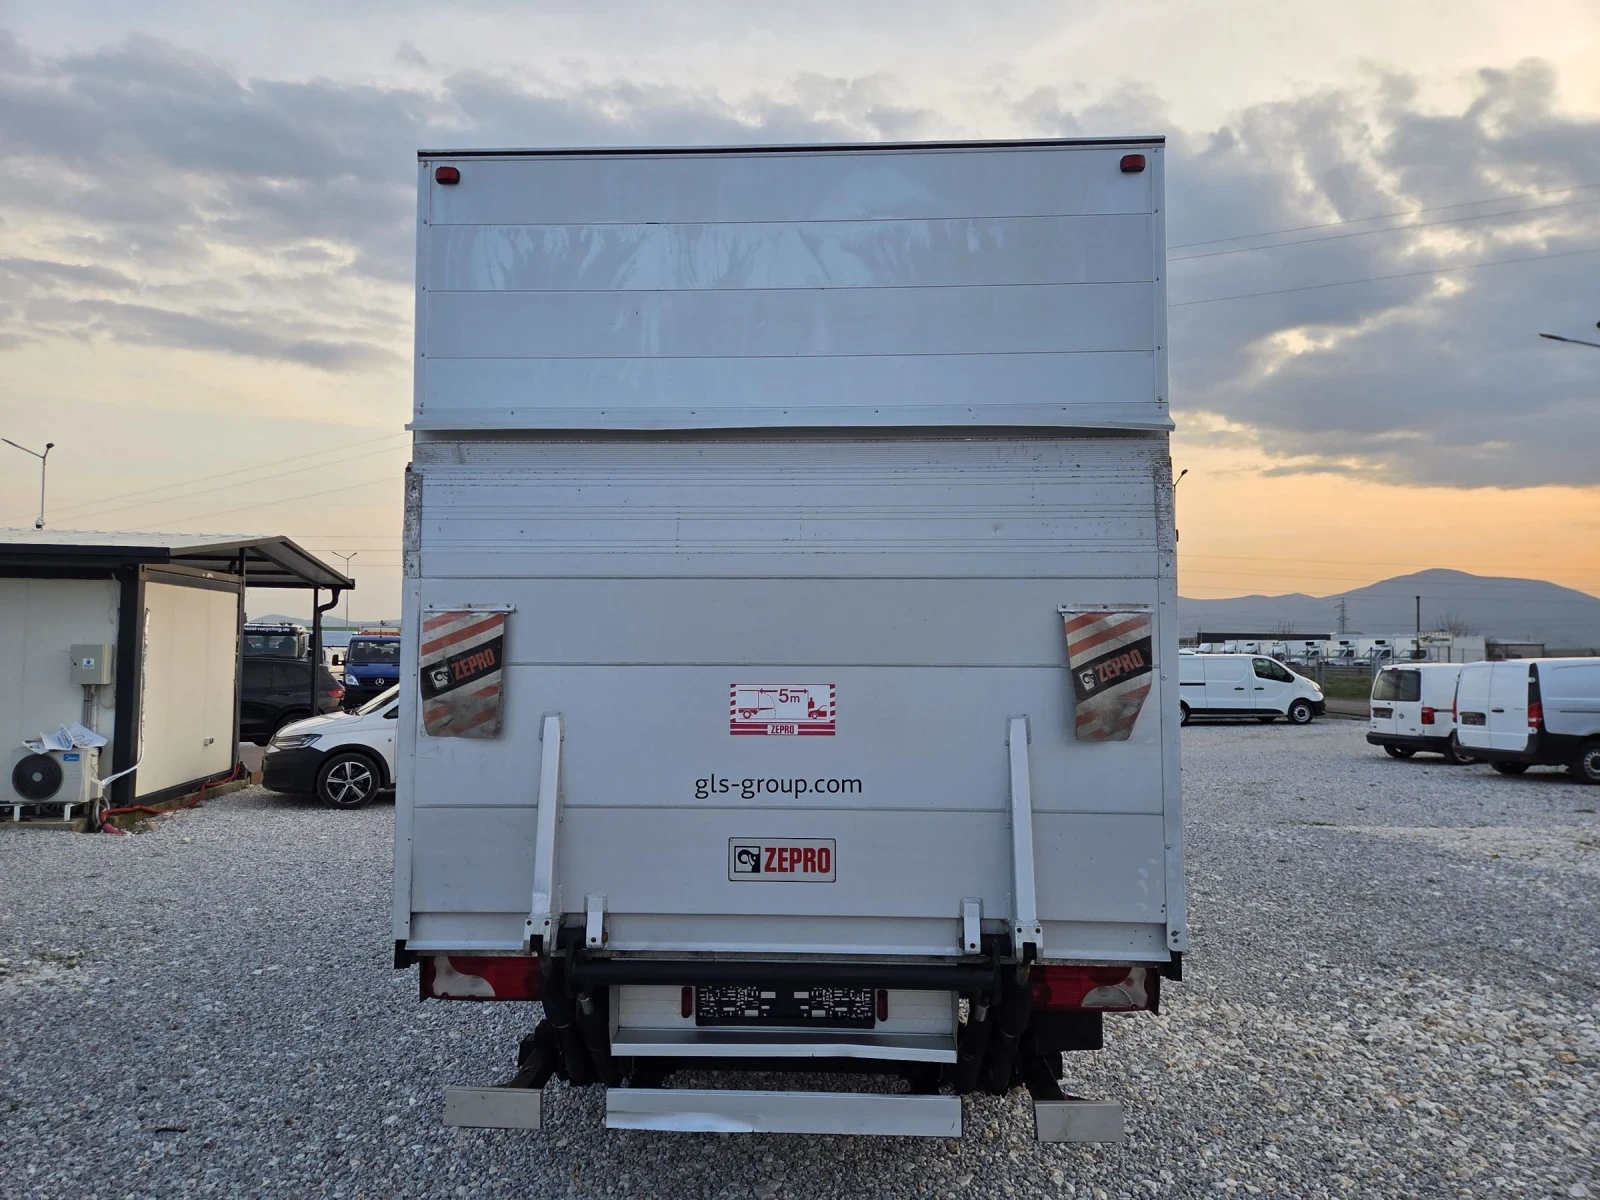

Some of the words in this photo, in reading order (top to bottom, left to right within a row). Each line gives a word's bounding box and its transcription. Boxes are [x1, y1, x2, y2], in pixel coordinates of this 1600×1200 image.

[451, 648, 495, 681] ZEPRO
[1095, 649, 1144, 683] ZEPRO
[770, 725, 795, 734] ZEPRO
[695, 773, 862, 799] gls-group.com
[764, 847, 831, 874] ZEPRO
